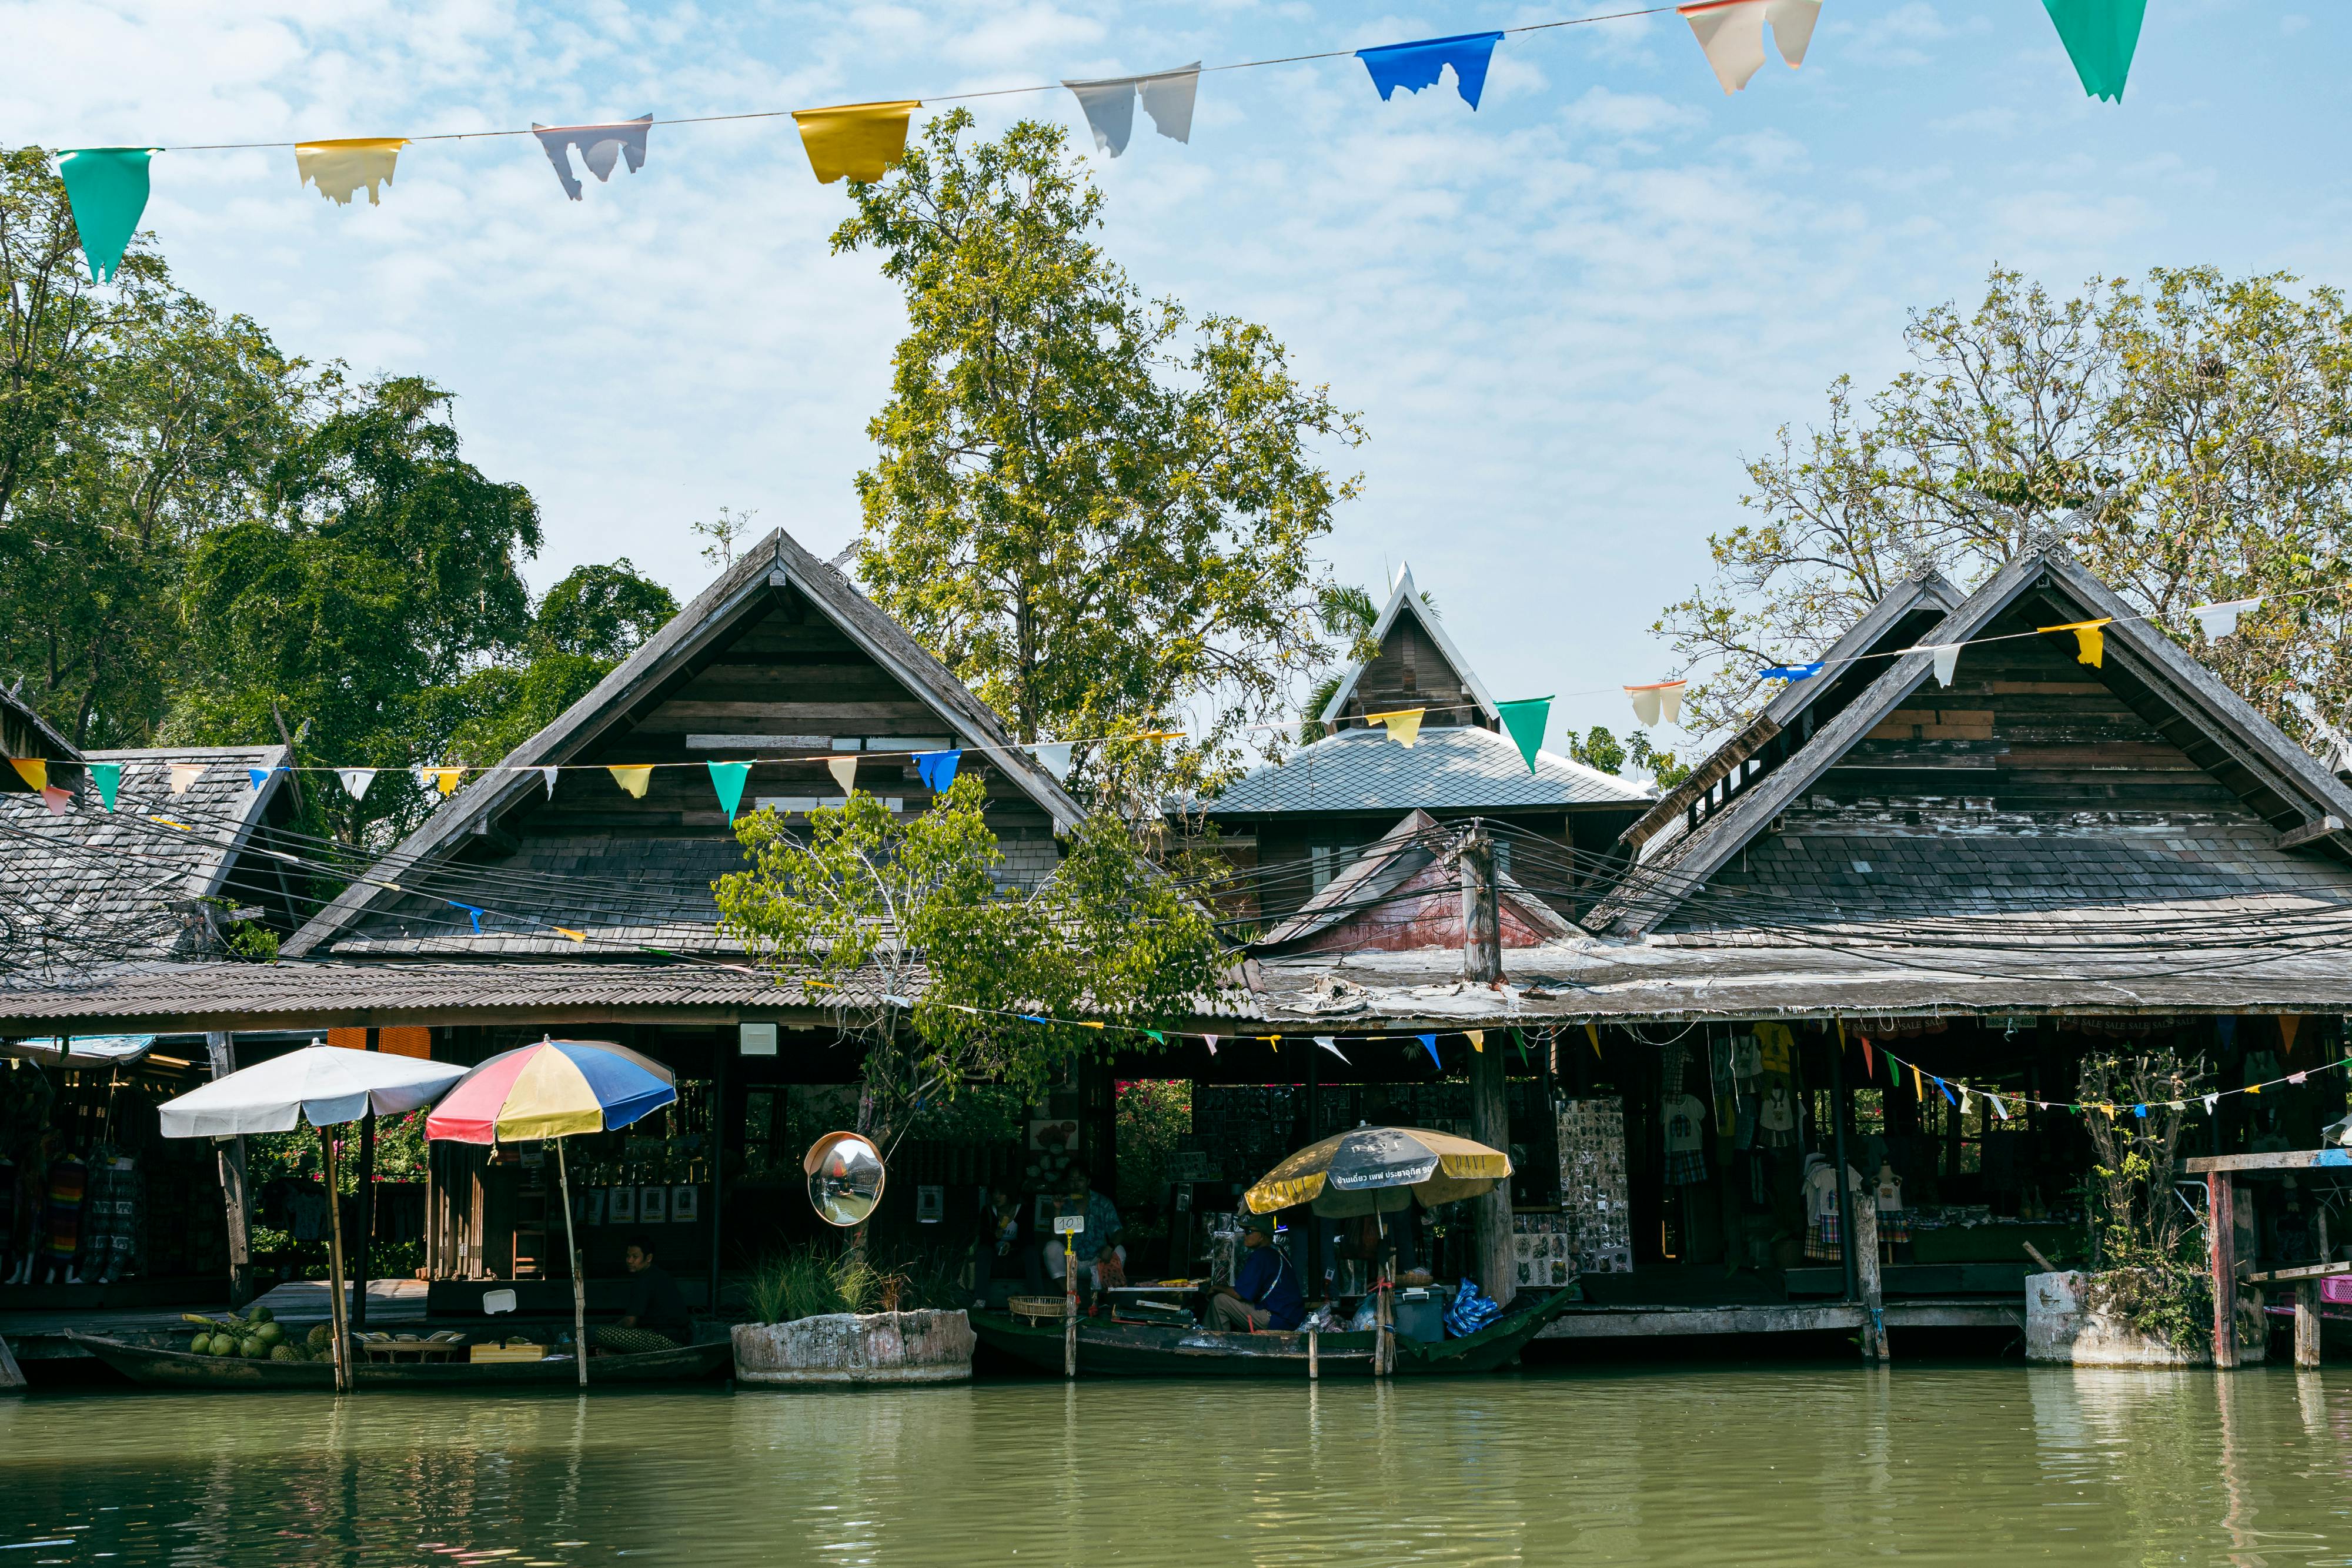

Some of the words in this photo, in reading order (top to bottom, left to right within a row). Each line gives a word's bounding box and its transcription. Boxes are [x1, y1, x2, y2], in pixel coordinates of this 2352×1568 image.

[1853, 1023, 1875, 1032] SALE
[1877, 1024, 1898, 1032] SALE
[1901, 1021, 1923, 1031] SALE
[1925, 1017, 1946, 1027] SALE
[1987, 1018, 2036, 1026] 080-57-4059
[2082, 1018, 2103, 1028] SALE
[2104, 1021, 2126, 1030] SALE
[2128, 1022, 2149, 1030] SALE
[2152, 1019, 2174, 1029] SALE
[2176, 1017, 2197, 1027] SALE
[1351, 1141, 1404, 1154] PAVE
[1337, 1173, 1367, 1184] บ้านเดี่ยว
[1385, 1167, 1421, 1178] ประชาอุทิศ
